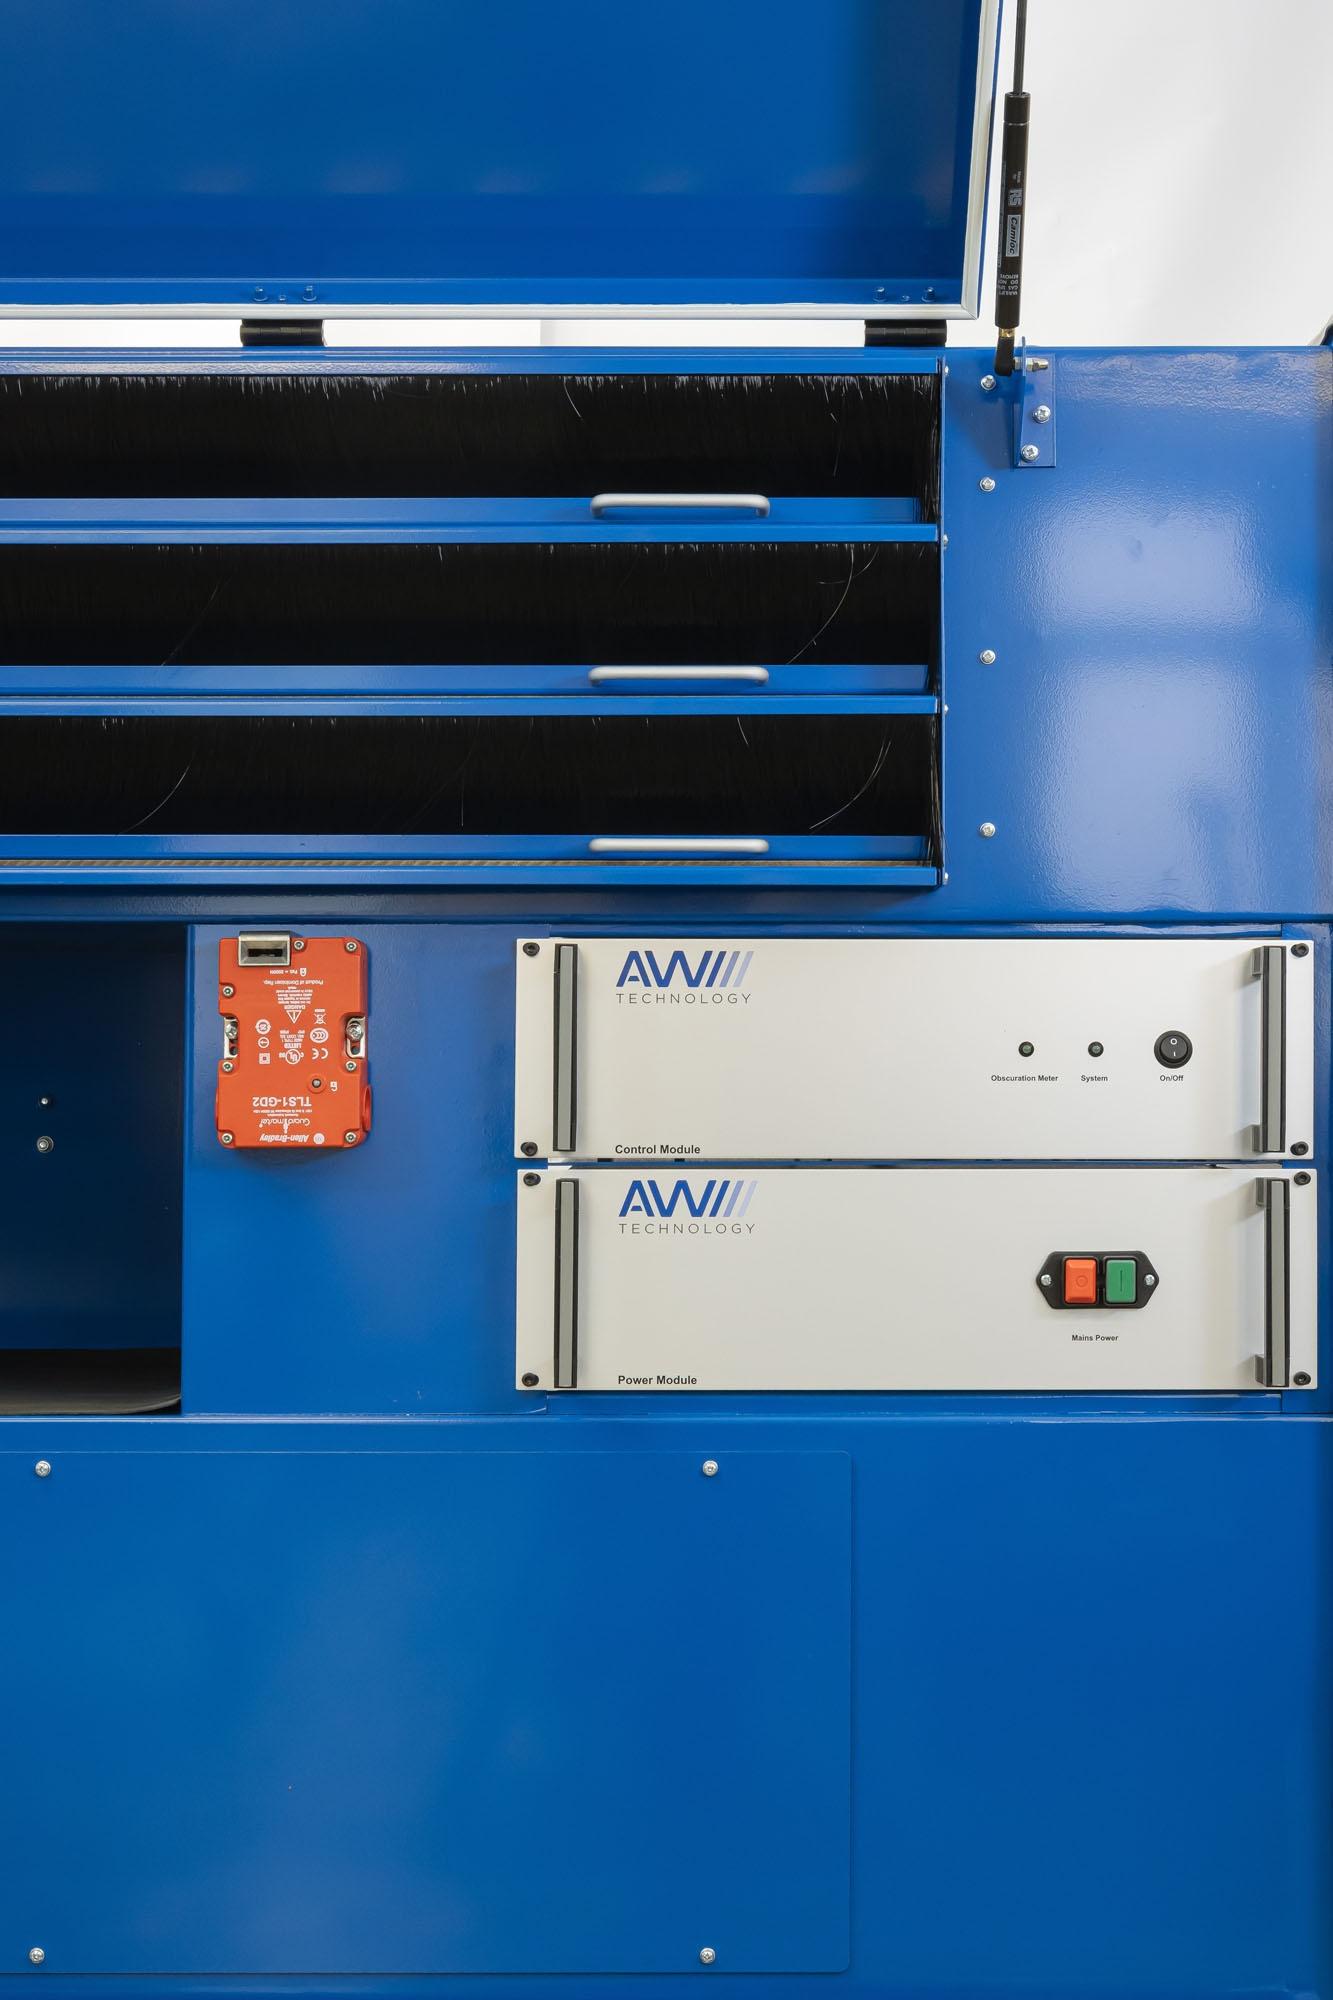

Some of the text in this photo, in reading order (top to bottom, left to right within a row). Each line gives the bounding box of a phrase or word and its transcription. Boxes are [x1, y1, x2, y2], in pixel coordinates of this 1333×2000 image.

[616, 993, 751, 1004] TECHNOLOGY
[991, 1074, 1059, 1082] Obscuration Meter
[1080, 1074, 1108, 1083] System
[1159, 1074, 1184, 1082] On/Off
[252, 1096, 312, 1107] TLS1-GD2
[259, 1133, 310, 1143] Allen-Bradley
[615, 1144, 701, 1154] Control Module
[619, 1223, 756, 1234] TECHNOLOGY
[618, 1375, 697, 1385] Power Module
